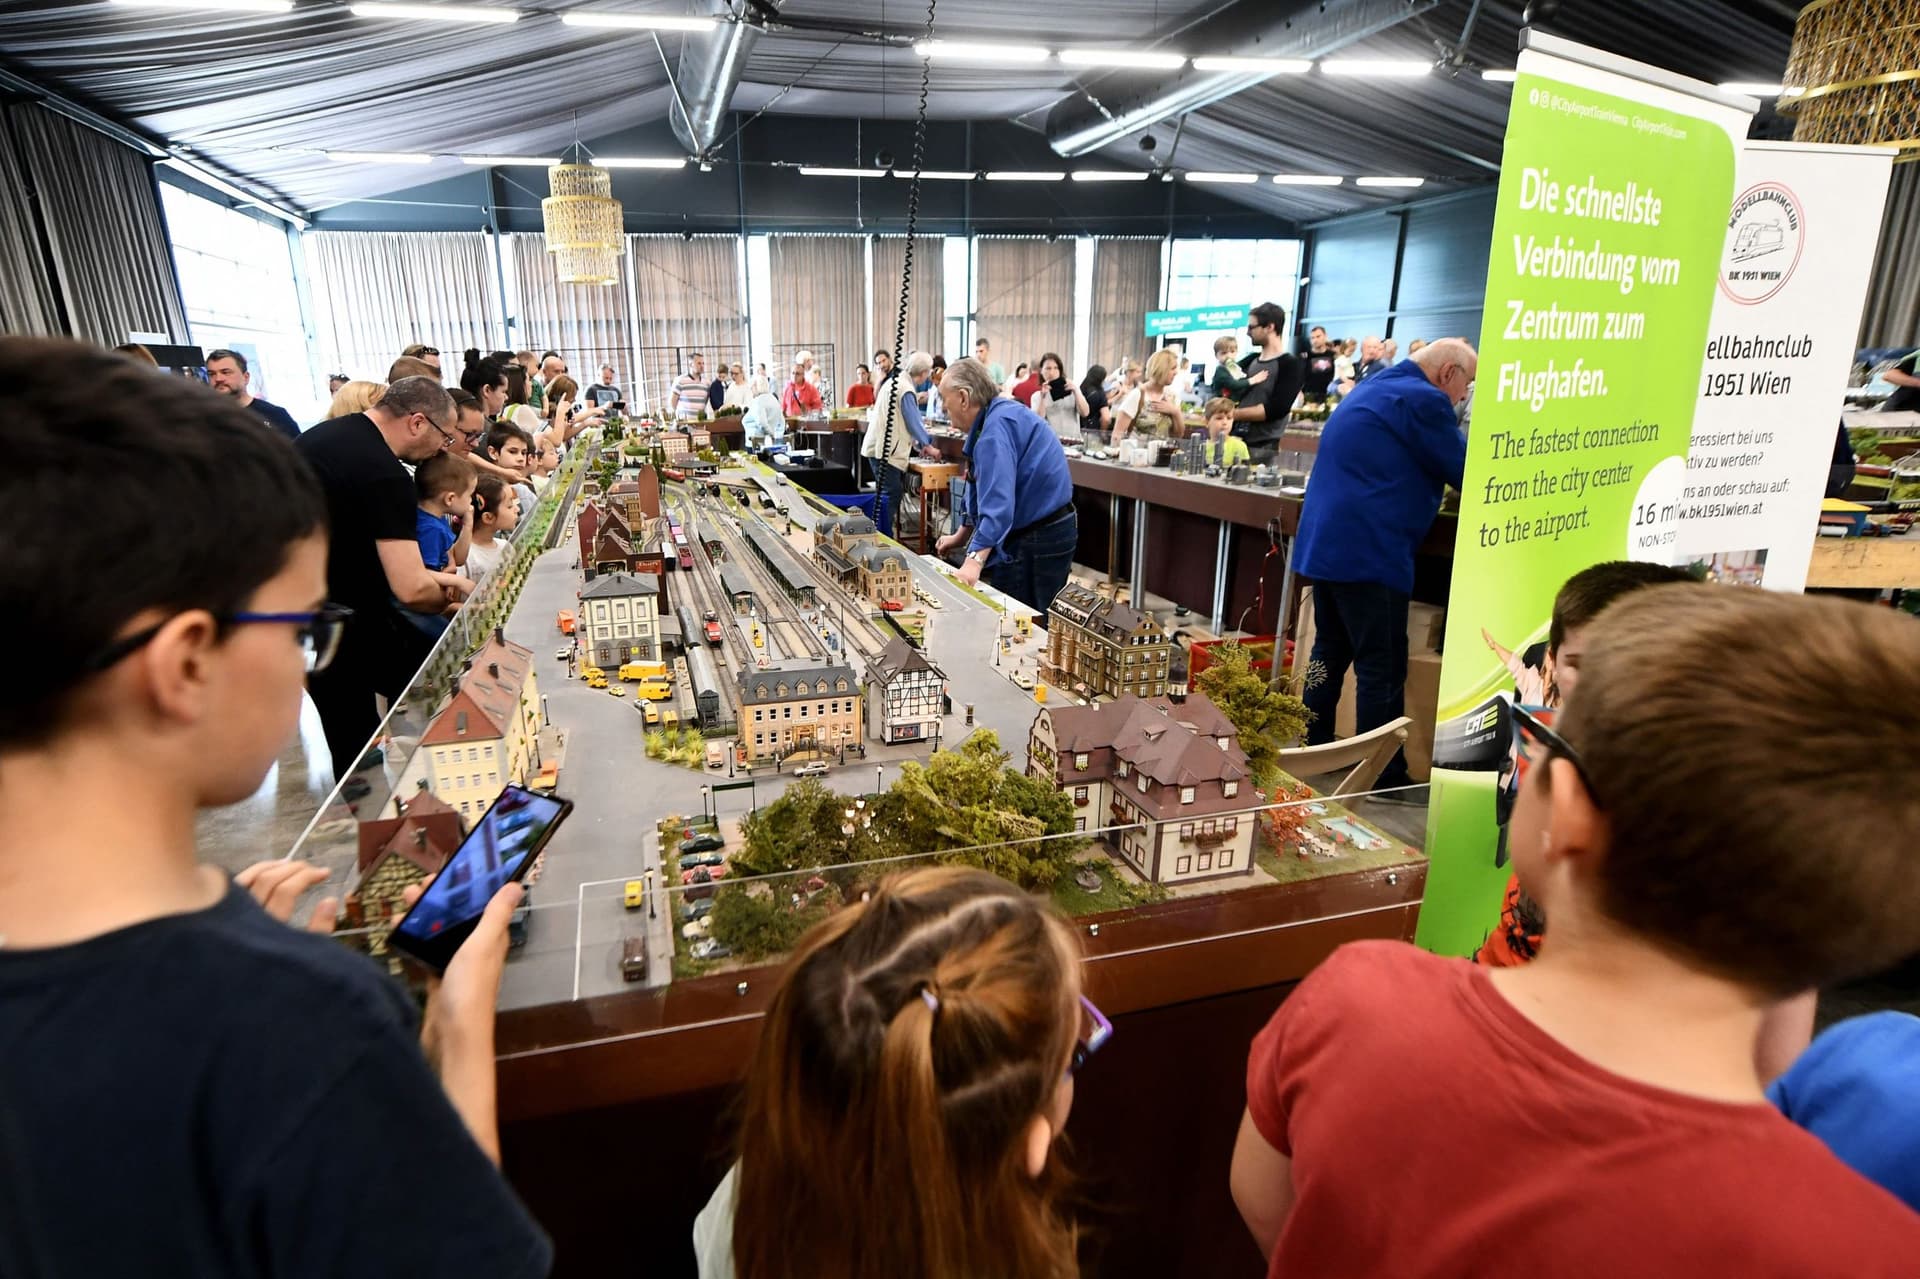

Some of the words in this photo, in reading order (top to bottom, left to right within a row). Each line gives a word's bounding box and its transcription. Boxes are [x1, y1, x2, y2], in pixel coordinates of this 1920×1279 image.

[1519, 167, 1559, 213] Die
[1563, 175, 1661, 226] schnellste
[1513, 234, 1637, 295] Verbindung
[1641, 255, 1680, 285] vom
[1503, 300, 1599, 340] Zentrum
[1603, 312, 1645, 340] zum
[1707, 334, 1812, 359] ellbahnclub
[1497, 358, 1608, 412] Flughafen.
[1704, 373, 1745, 397] 1951
[1750, 371, 1791, 395] Wien
[1490, 431, 1525, 460] The
[1529, 426, 1580, 456] fastest
[1583, 420, 1659, 448] connection
[1737, 430, 1753, 445] bei
[1754, 431, 1773, 444] uns
[1705, 457, 1719, 468] zu
[1720, 451, 1764, 467] werden?
[1483, 476, 1528, 504] from
[1533, 470, 1557, 496] the
[1561, 467, 1589, 498] city
[1592, 461, 1633, 487] center
[1698, 485, 1711, 497] an
[1713, 482, 1737, 496] oder
[1738, 480, 1768, 495] schau
[1770, 478, 1790, 493] auf:
[1480, 523, 1500, 547] to
[1505, 516, 1530, 544] the
[1534, 505, 1590, 541] airport.
[1636, 503, 1656, 526] 16
